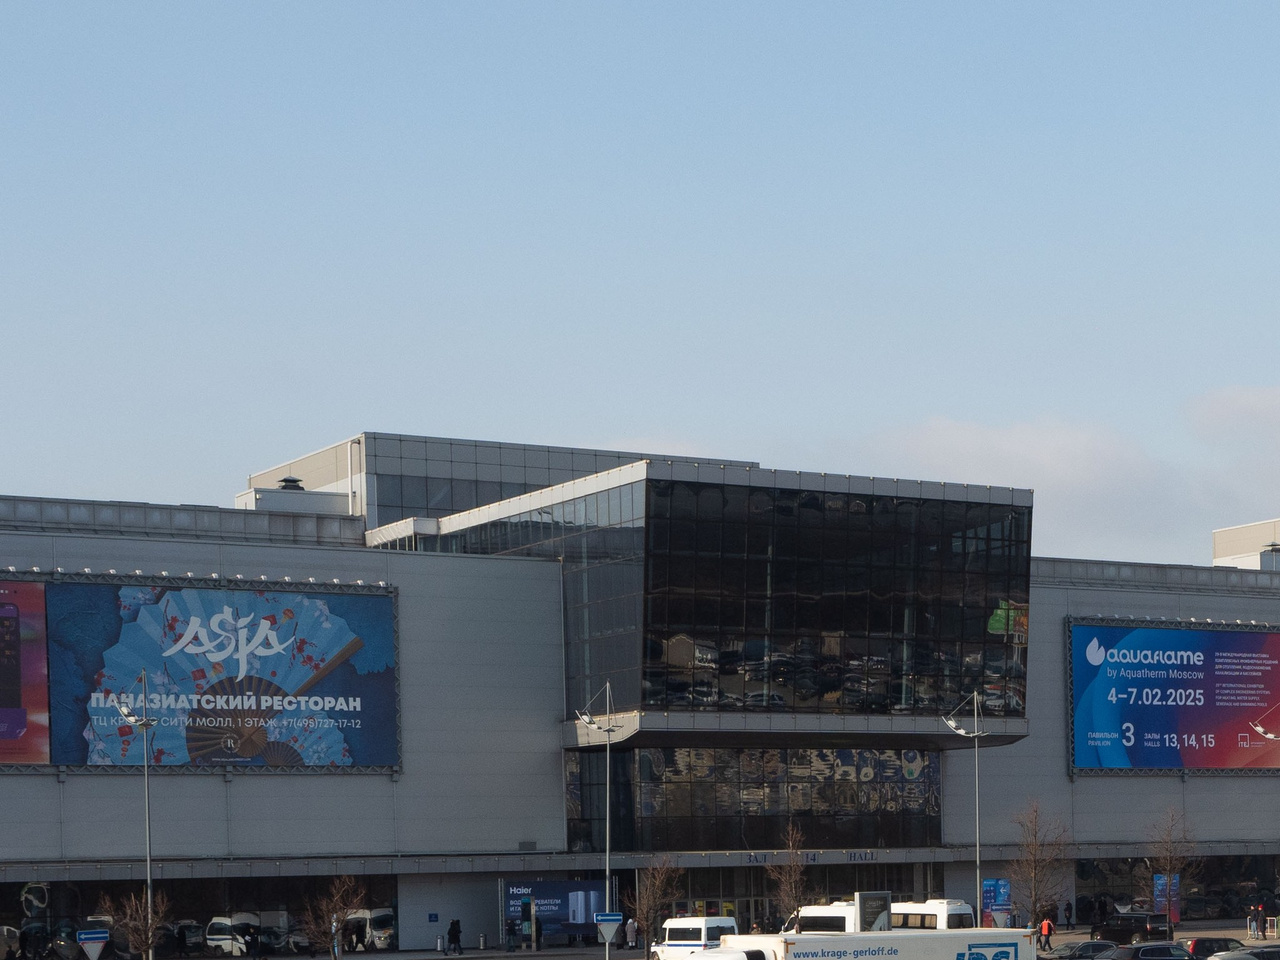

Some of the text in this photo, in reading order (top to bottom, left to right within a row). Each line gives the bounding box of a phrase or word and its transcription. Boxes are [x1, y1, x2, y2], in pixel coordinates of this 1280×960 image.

[1106, 648, 1204, 666] aquaflame
[1107, 667, 1205, 680] by Aquatherm Moscow
[260, 696, 361, 711] РЕСТОРАН
[92, 716, 107, 726] ТЦ
[161, 717, 193, 726] СИТИ
[237, 718, 242, 727] 1
[244, 718, 277, 728] ЭТАЖ
[1121, 722, 1135, 746] 3
[1163, 733, 1215, 750] 13, 14, 15
[746, 852, 877, 863] ЗАЛ 14 HALL
